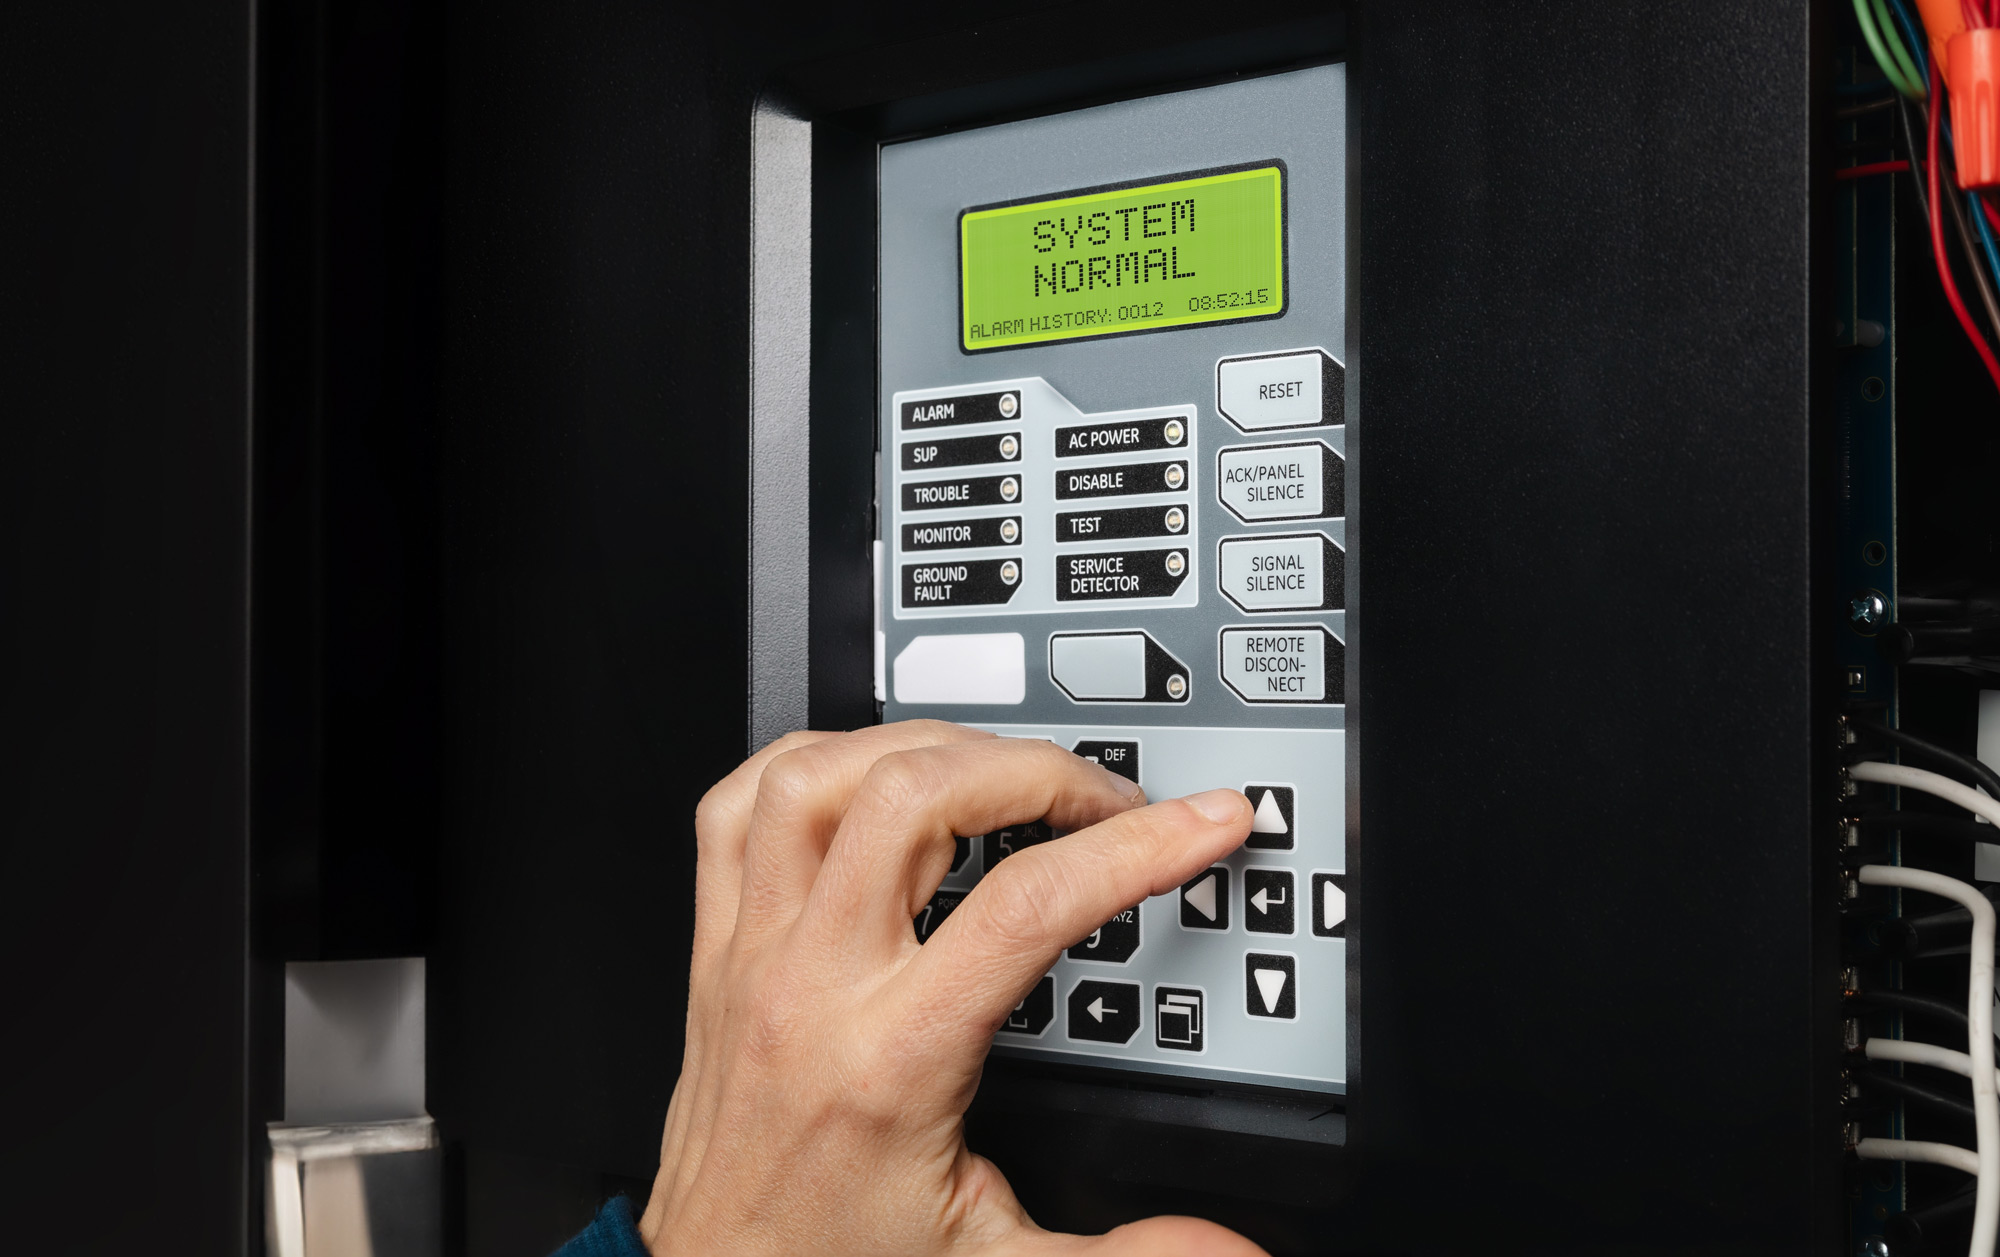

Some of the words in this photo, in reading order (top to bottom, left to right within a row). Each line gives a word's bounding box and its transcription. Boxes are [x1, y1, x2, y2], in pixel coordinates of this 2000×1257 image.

[1034, 199, 1195, 253] SYSTEM
[1034, 246, 1195, 297] NORMAL
[971, 319, 1023, 338] ALARM
[1031, 309, 1112, 331] HISTORY:
[1119, 302, 1163, 320] 0012
[1189, 289, 1268, 312] 08:52:15
[1260, 381, 1302, 399] RESET
[913, 404, 954, 422] ALARM
[1069, 433, 1087, 448] AC
[1091, 428, 1139, 446] POWER
[914, 447, 937, 463] SUP
[1070, 473, 1123, 491] DISABLE
[1226, 464, 1304, 483] ACK/PANEL
[914, 485, 969, 503] TROUBLE
[1248, 484, 1304, 502] SILENCE
[1070, 517, 1101, 533] TEST
[914, 526, 971, 544] MONITOR
[1071, 557, 1123, 574] SERVICE
[1252, 555, 1304, 571] SIGNAL
[914, 566, 967, 583] GROUND
[1247, 574, 1305, 591] SILENCE
[915, 585, 952, 601] FAULT
[1071, 575, 1139, 593] DETECTOR
[1247, 637, 1304, 652] REMOTE
[1245, 657, 1305, 672] DISCON-
[1268, 677, 1305, 692] NECT
[1105, 748, 1126, 761] DEF
[1022, 824, 1040, 838] JKL
[1000, 832, 1012, 860] 5
[922, 905, 933, 936] 7
